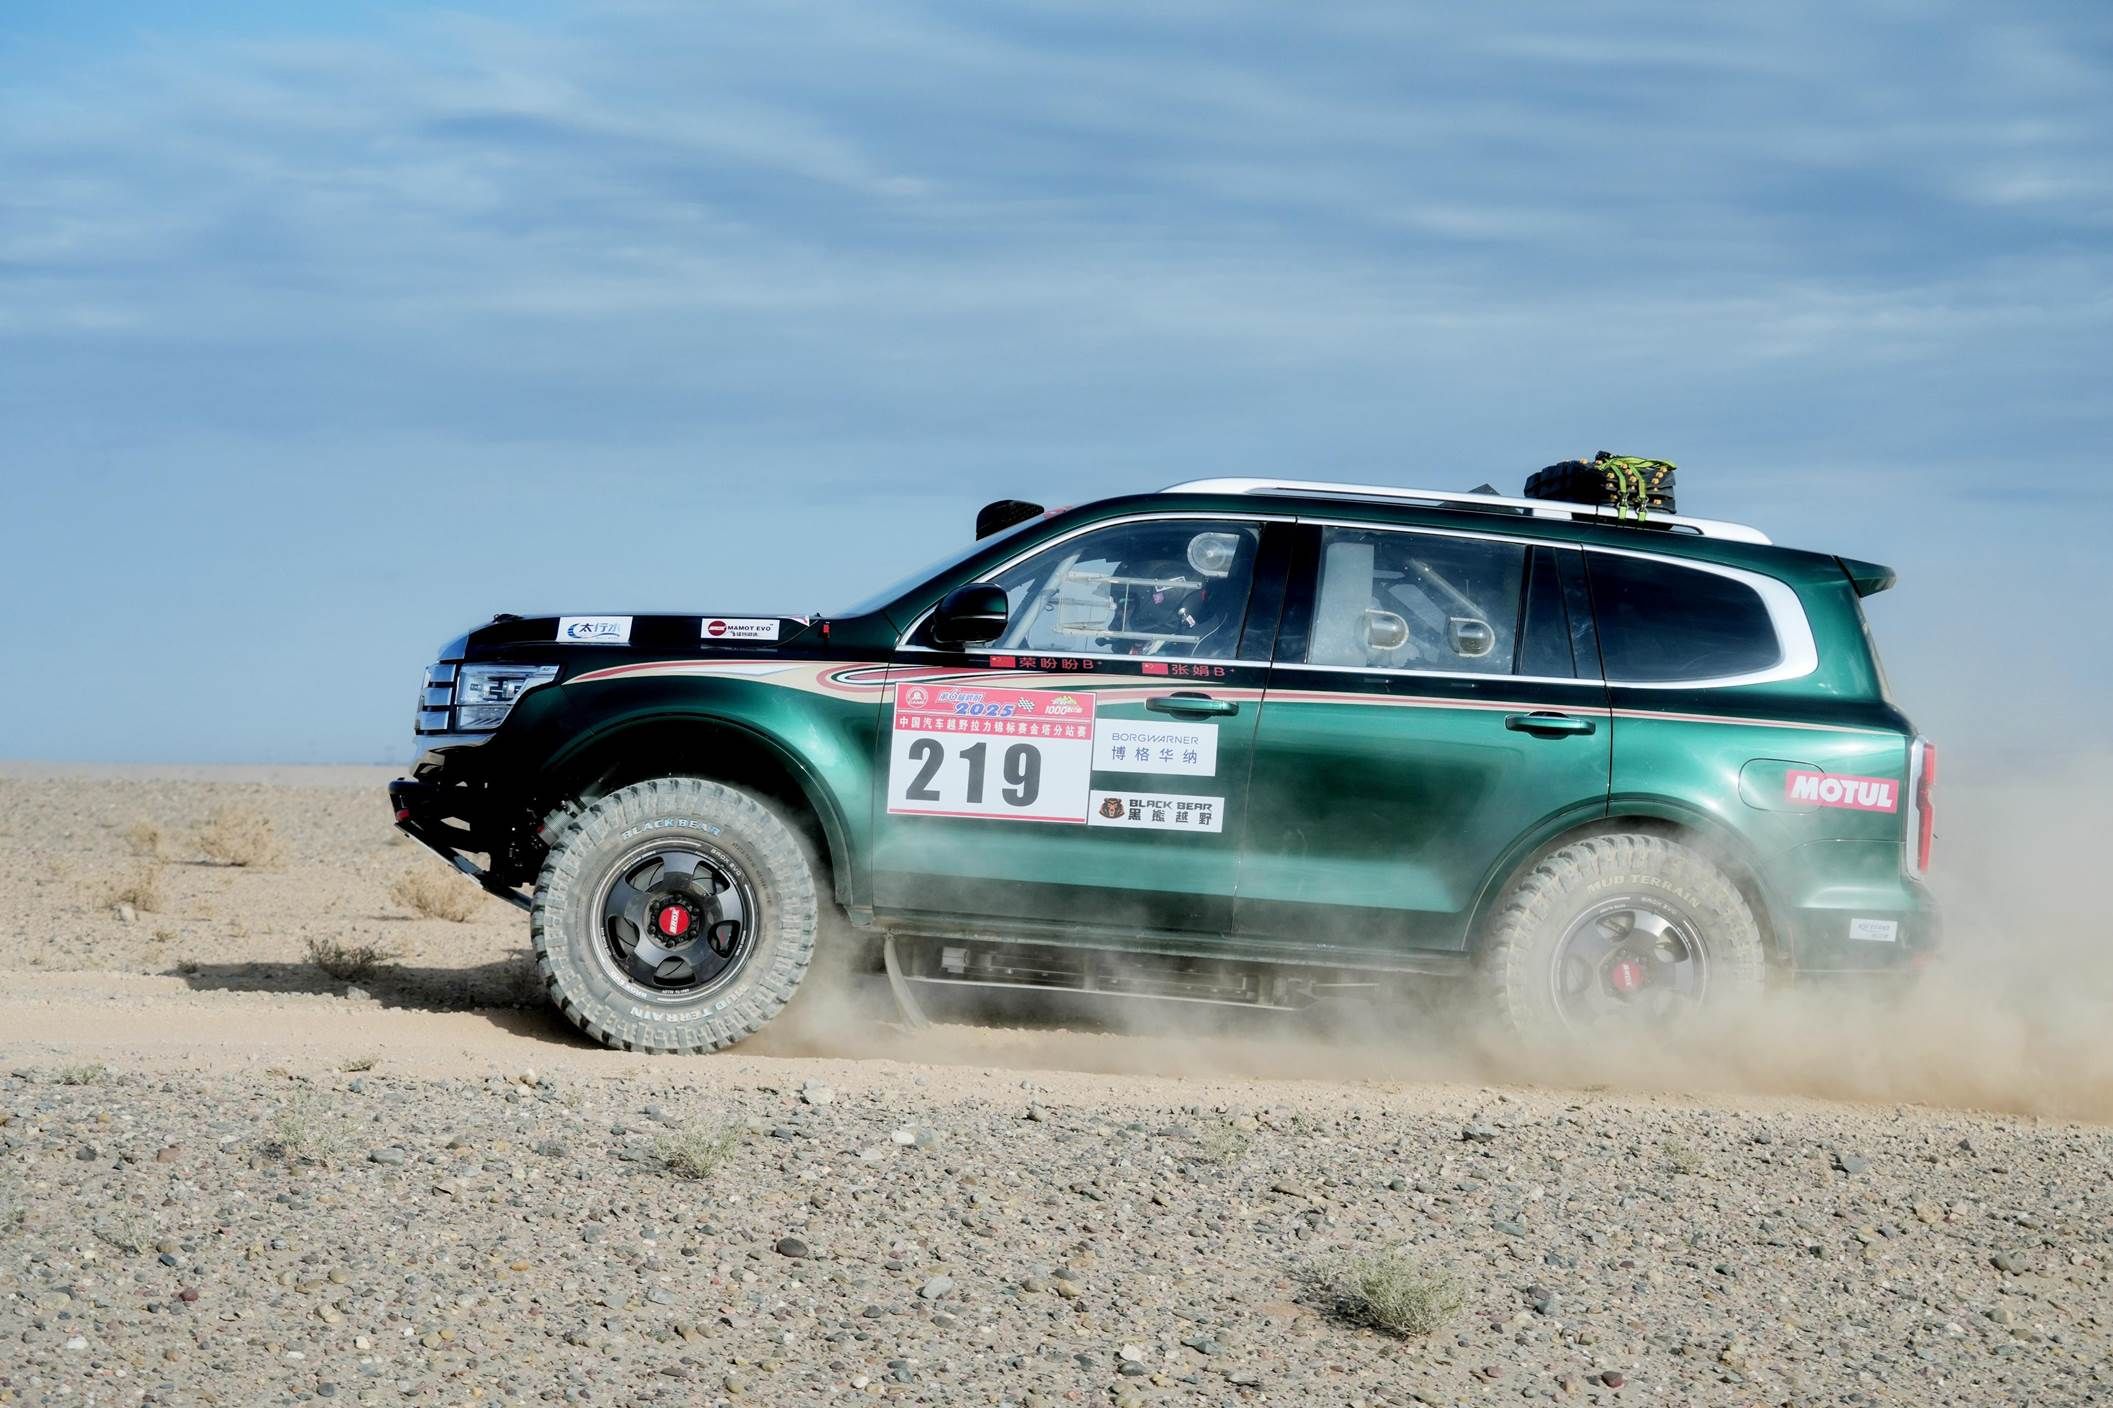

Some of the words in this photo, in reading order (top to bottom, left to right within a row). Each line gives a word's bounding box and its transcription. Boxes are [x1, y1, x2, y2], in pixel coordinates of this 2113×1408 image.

[955, 702, 1015, 717] 2025
[899, 716, 1087, 738] 中国汽车越野拉力锦标赛金塔分站赛
[1112, 732, 1199, 745] BORGWARNER
[1112, 746, 1198, 764] 博格华纳
[905, 738, 1041, 807] 219
[1791, 775, 1893, 808] MOTUL
[1129, 799, 1173, 809] BLACK
[1176, 801, 1213, 811] BEAR
[1128, 808, 1212, 825] 黑熊越野
[622, 818, 673, 840] BLACK
[679, 819, 720, 837] BEAR
[1586, 875, 1625, 895] MUD
[1630, 874, 1701, 908] TERRAIN
[630, 1006, 713, 1022] TERRAIN
